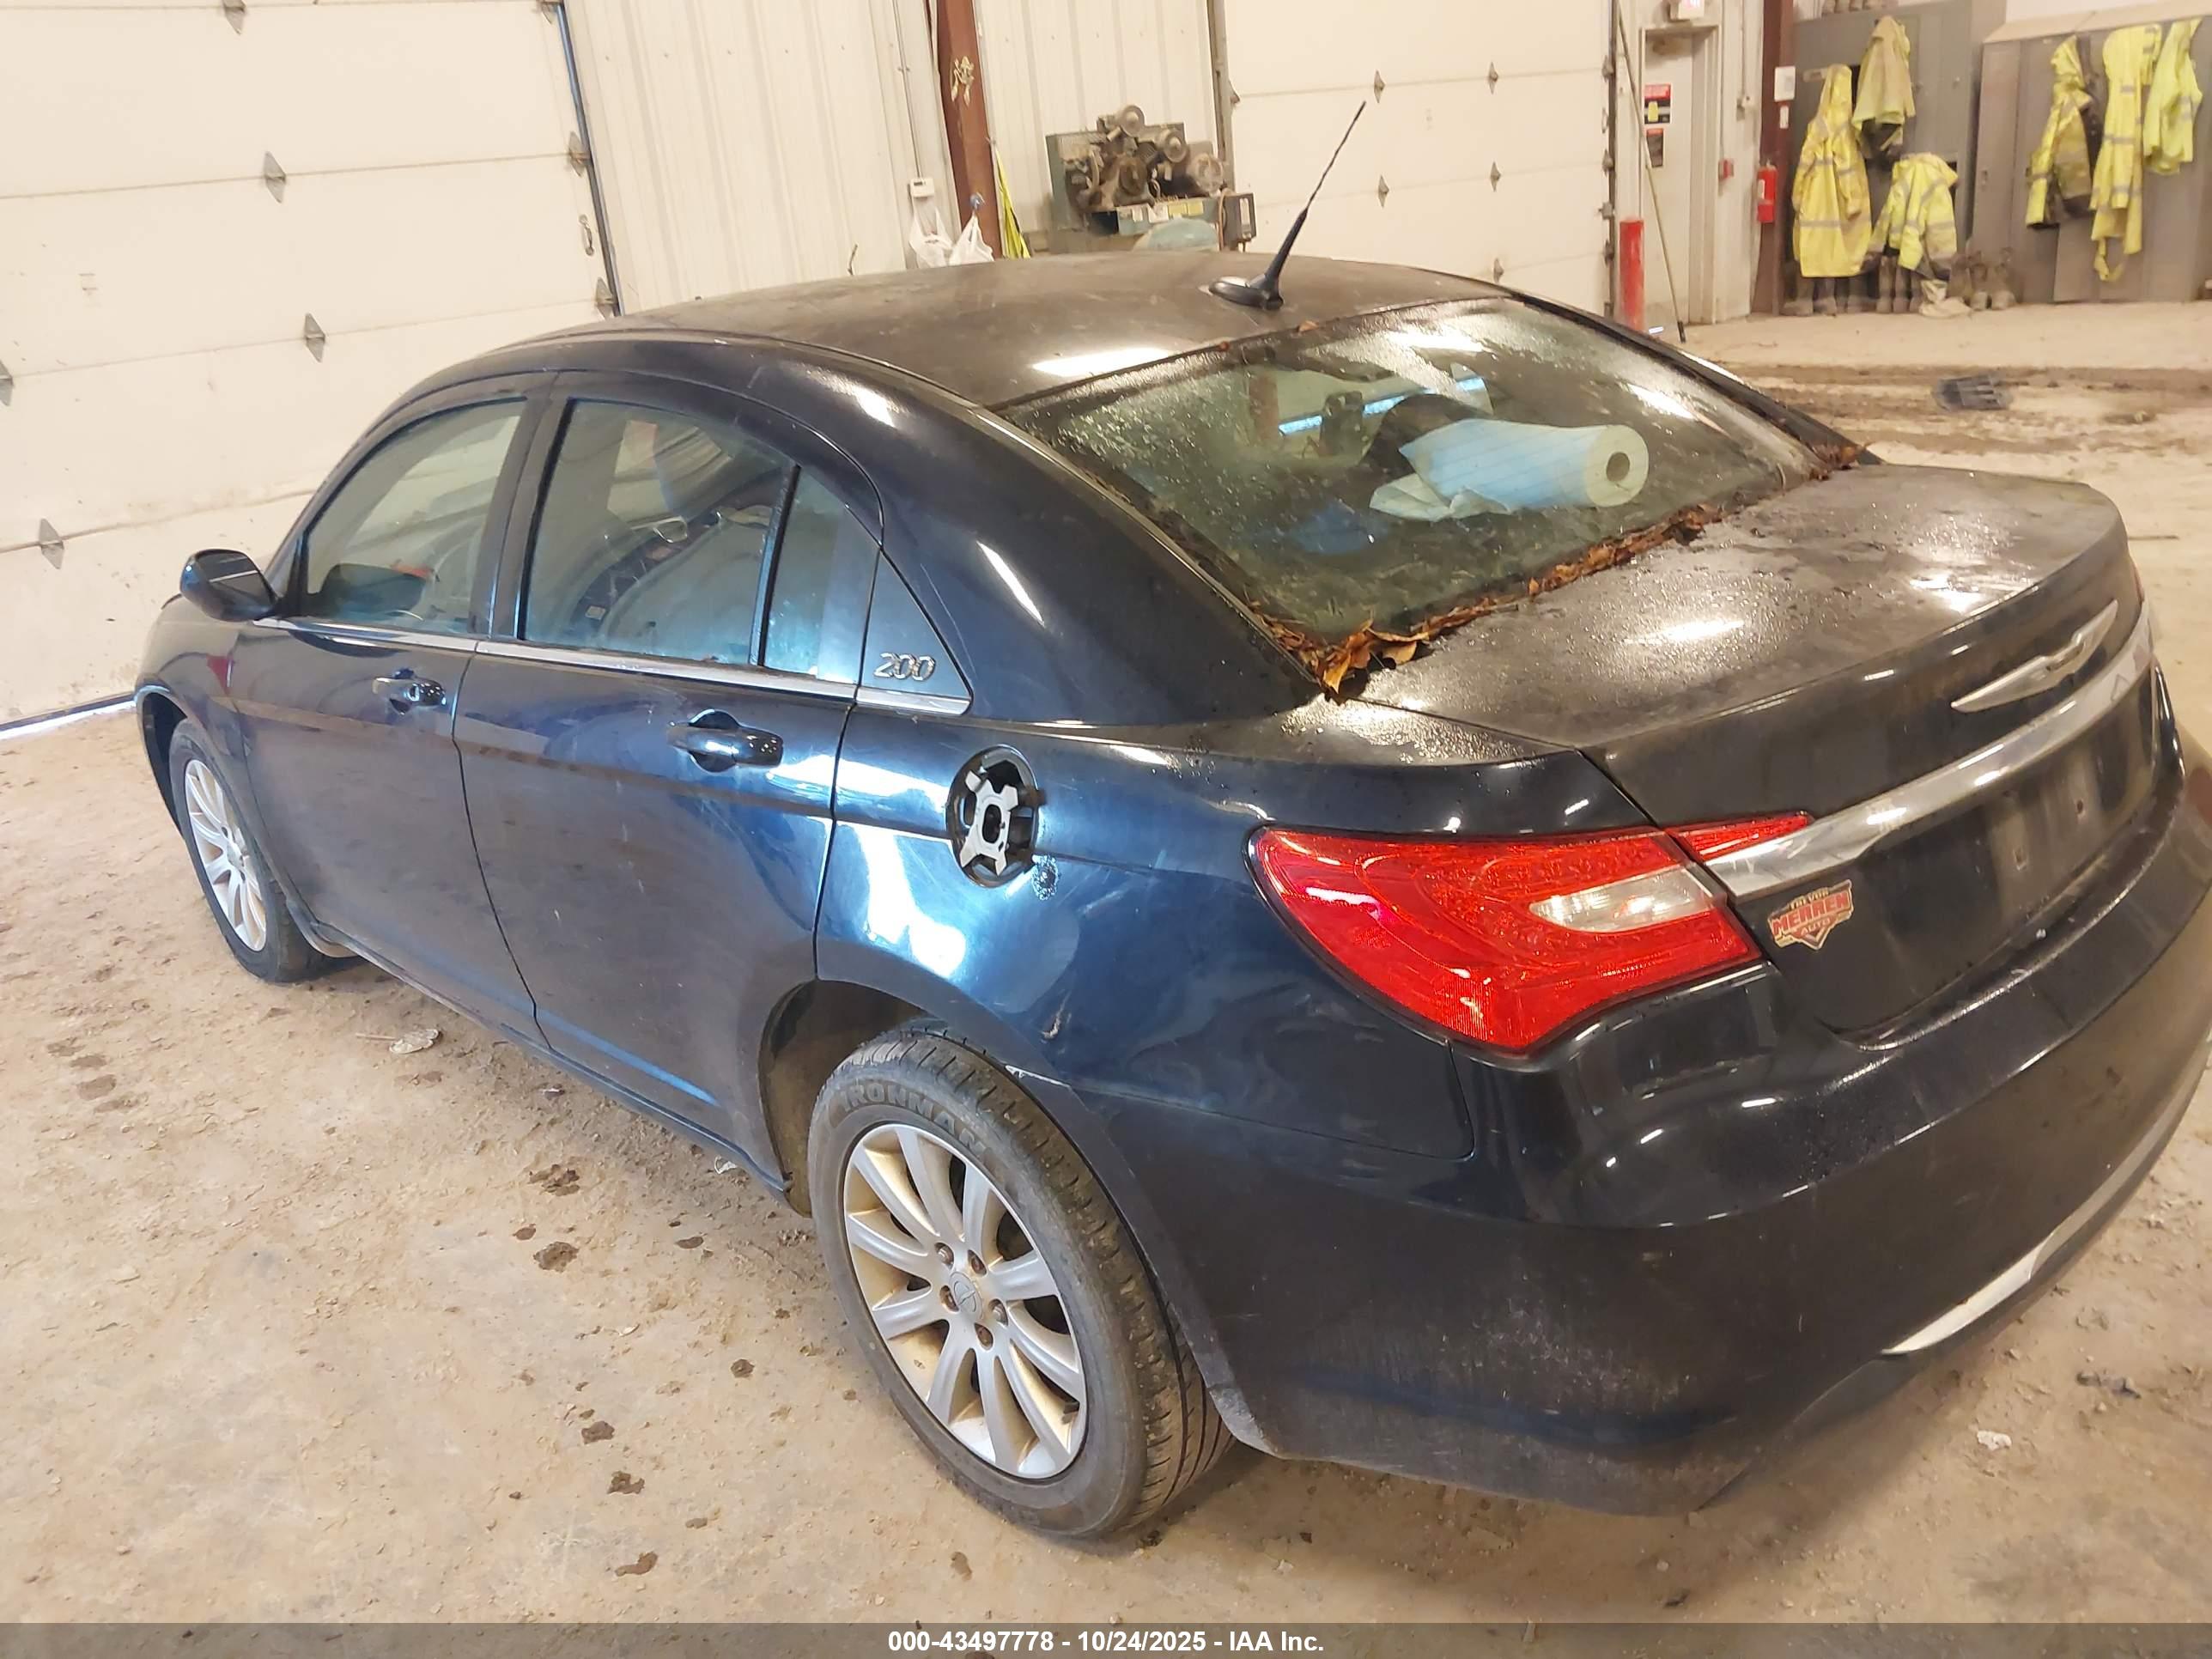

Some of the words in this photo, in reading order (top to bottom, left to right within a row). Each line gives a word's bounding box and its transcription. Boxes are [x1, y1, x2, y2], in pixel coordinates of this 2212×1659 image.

[873, 652, 936, 680] 200
[1801, 919, 1831, 936] AUTO
[842, 1081, 988, 1157] IRONMAN
